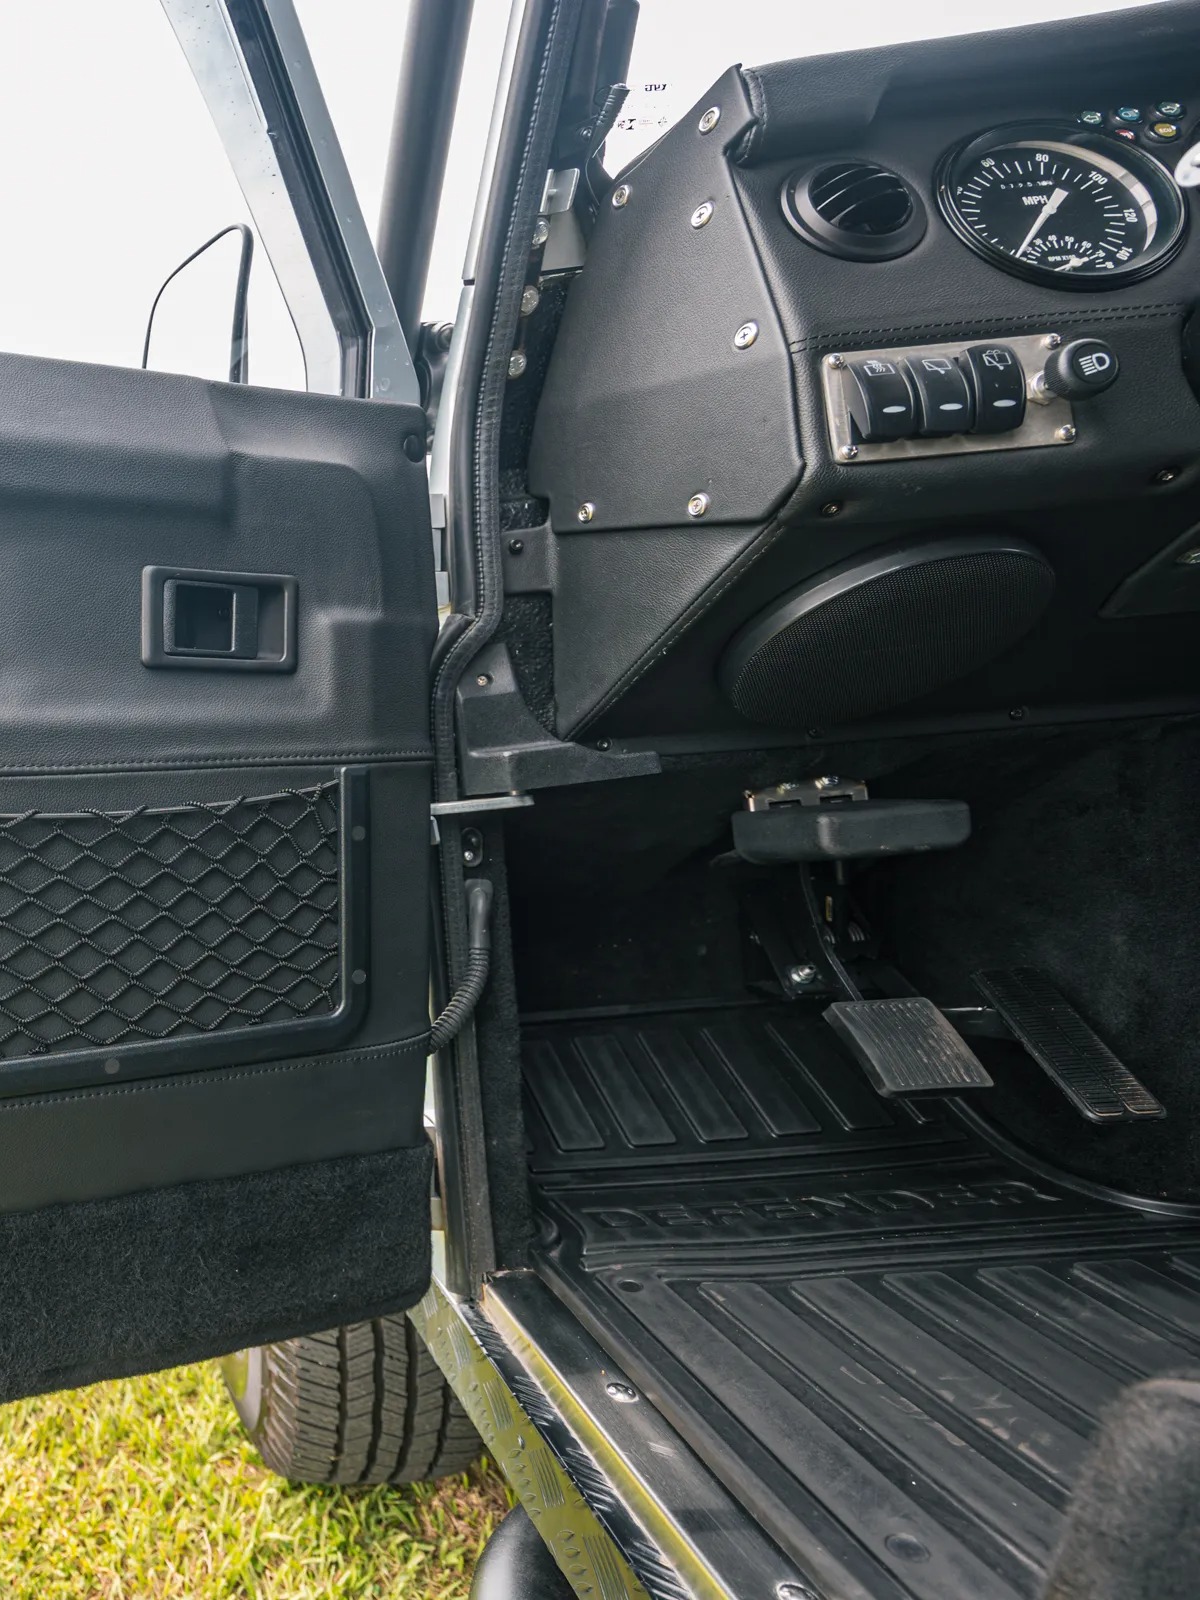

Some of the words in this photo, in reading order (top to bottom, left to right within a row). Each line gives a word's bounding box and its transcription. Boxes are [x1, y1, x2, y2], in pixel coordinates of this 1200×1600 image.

[981, 157, 996, 168] 60
[1035, 153, 1049, 162] 80
[1088, 171, 1108, 185] 100
[1022, 195, 1049, 206] MPH
[1123, 208, 1138, 222] 120
[1116, 246, 1133, 260] 140
[581, 1179, 1063, 1227] DEFENDER
